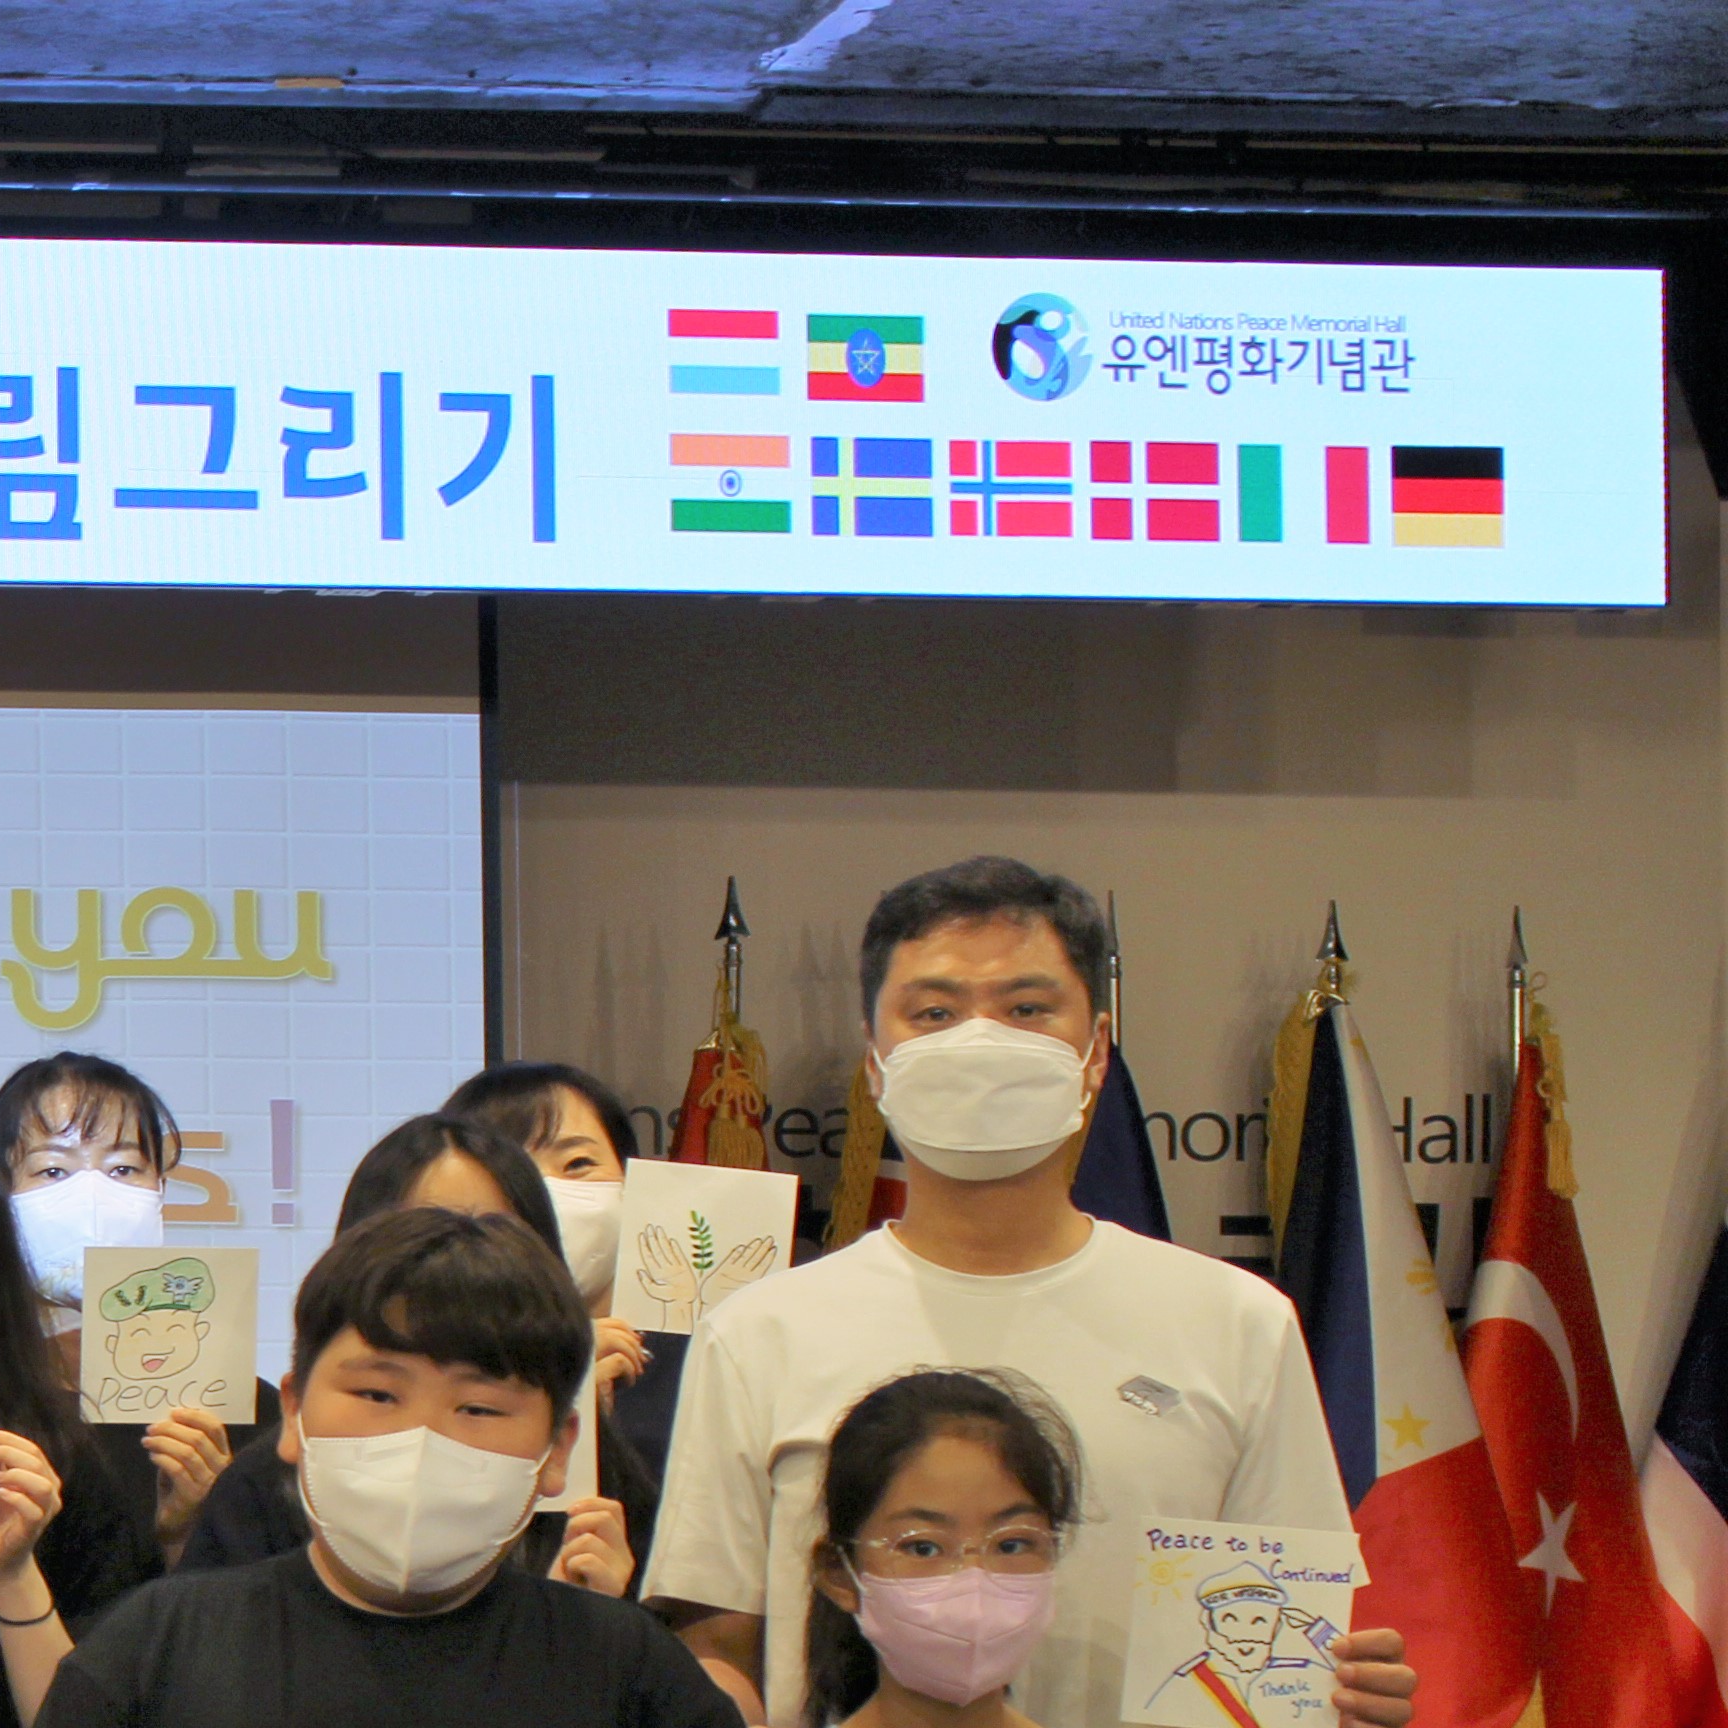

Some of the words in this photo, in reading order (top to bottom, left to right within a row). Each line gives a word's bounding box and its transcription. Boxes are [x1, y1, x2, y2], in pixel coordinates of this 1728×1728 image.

[1109, 311, 1164, 329] United
[1169, 312, 1233, 330] Nations
[1237, 313, 1287, 331] Peace
[1291, 314, 1372, 333] Memorial
[1375, 315, 1407, 333] Hall
[1101, 334, 1416, 396] 유엔평화기념관
[1146, 1527, 1214, 1552] Peace
[1225, 1535, 1249, 1553] to
[1259, 1535, 1284, 1555] be
